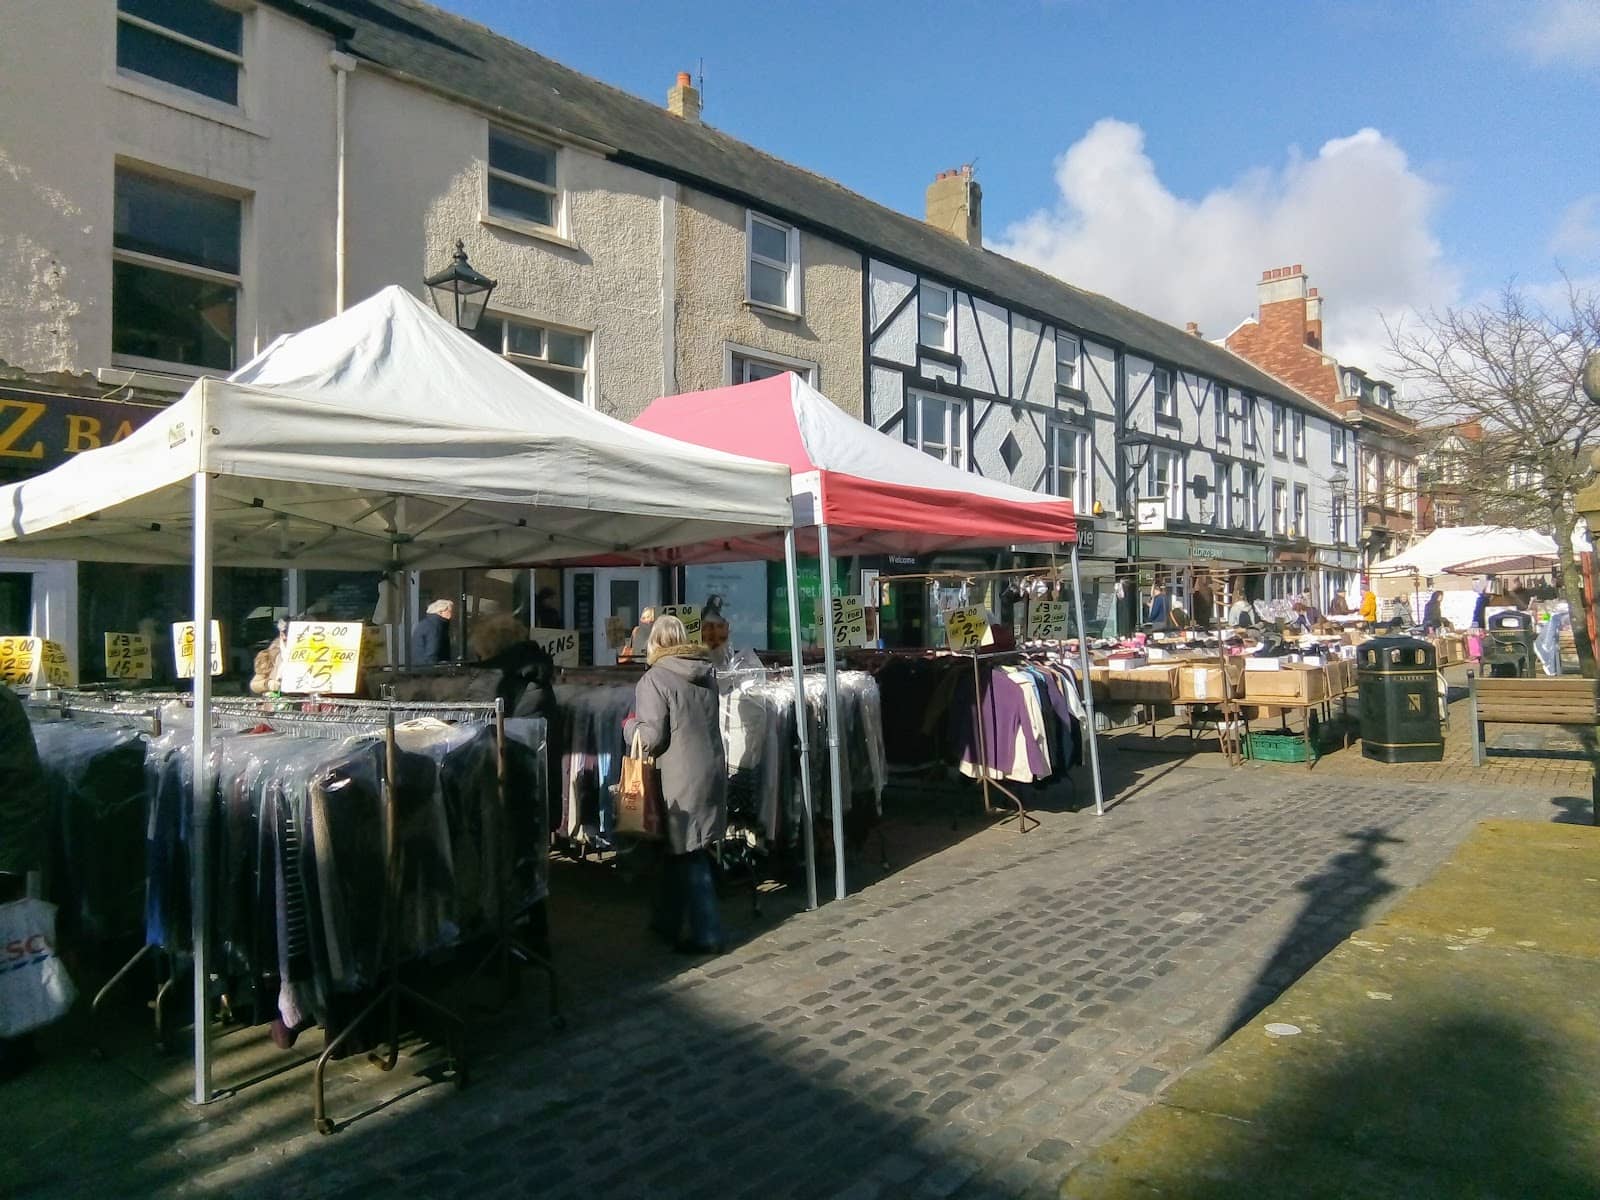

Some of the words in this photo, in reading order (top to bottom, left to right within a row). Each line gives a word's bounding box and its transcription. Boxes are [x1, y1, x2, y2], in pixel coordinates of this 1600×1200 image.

[0, 399, 47, 459] Z
[1076, 530, 1094, 548] yle
[888, 555, 915, 564] Welcome
[834, 611, 844, 625] 2
[1043, 613, 1051, 623] 2
[296, 625, 348, 643] £3.00
[834, 625, 861, 643] 5.00
[962, 622, 974, 635] 2
[122, 647, 132, 659] 2
[291, 649, 307, 660] OR
[313, 646, 330, 663] 2
[334, 652, 354, 661] FOR
[3, 658, 17, 671] 2
